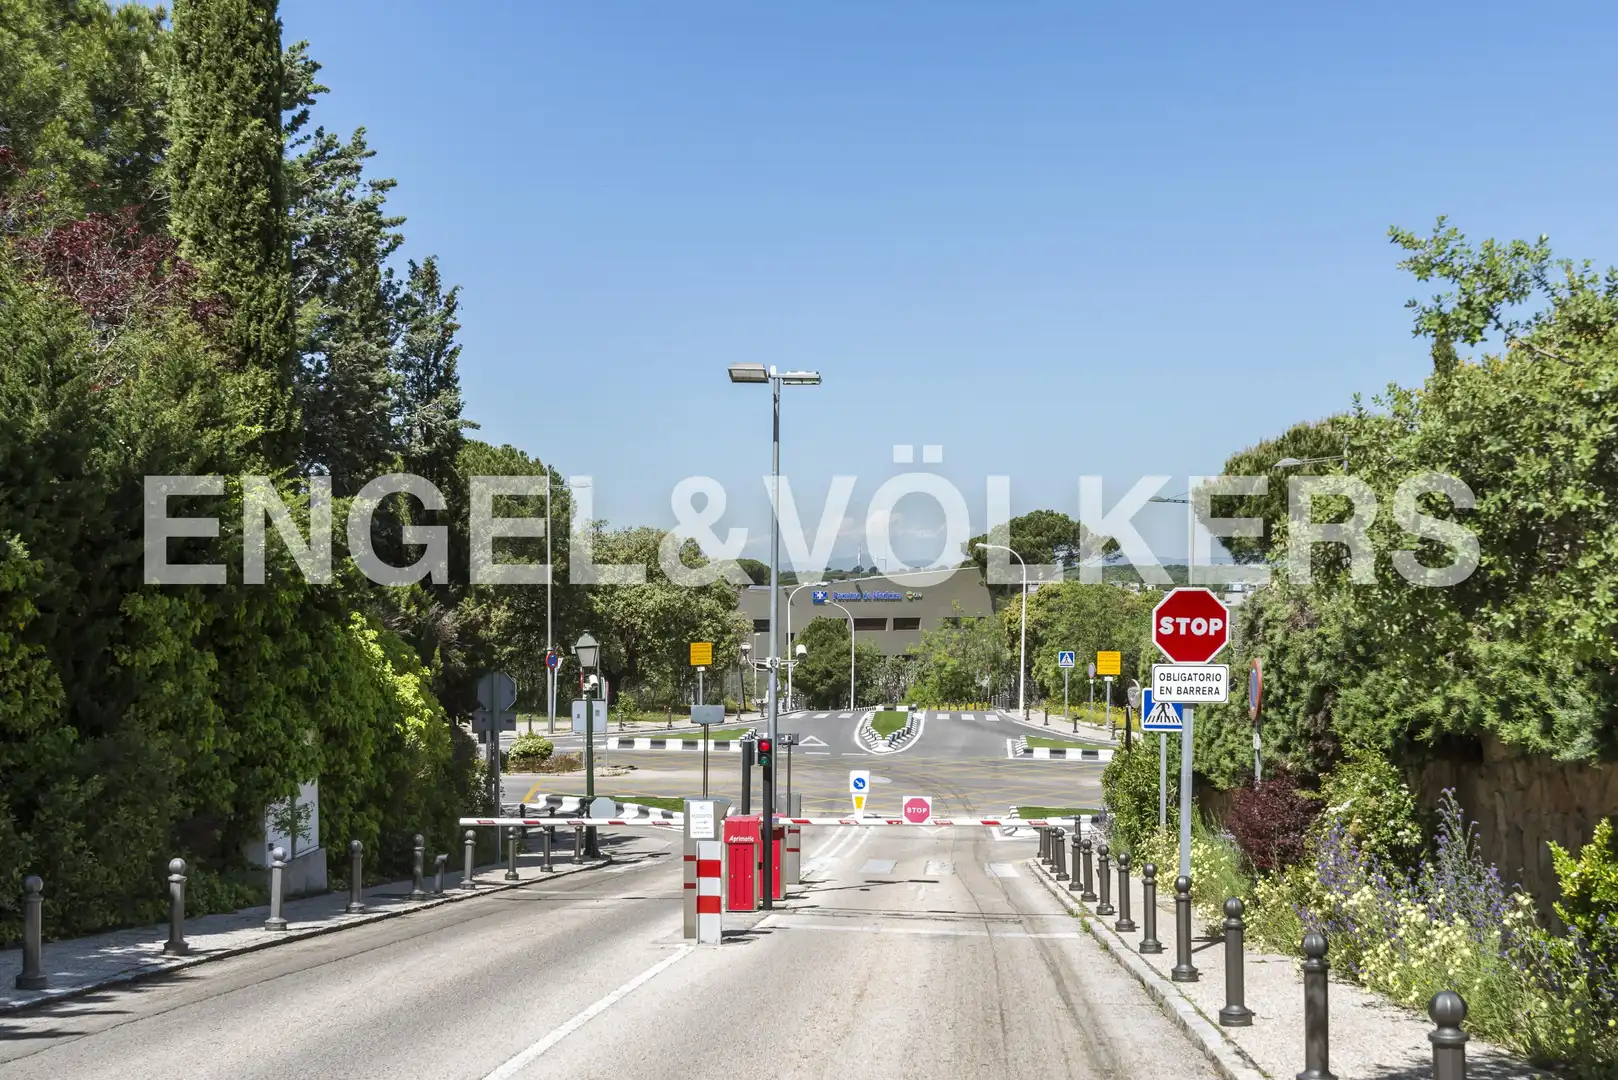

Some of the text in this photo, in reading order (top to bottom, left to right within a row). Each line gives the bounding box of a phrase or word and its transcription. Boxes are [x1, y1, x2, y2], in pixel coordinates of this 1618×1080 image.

[1158, 616, 1223, 636] STOP
[1159, 672, 1222, 682] OBLIGATORIO
[1160, 686, 1220, 695] EN BARRERA
[906, 806, 928, 814] STOP
[728, 834, 755, 843] Aprimatic
